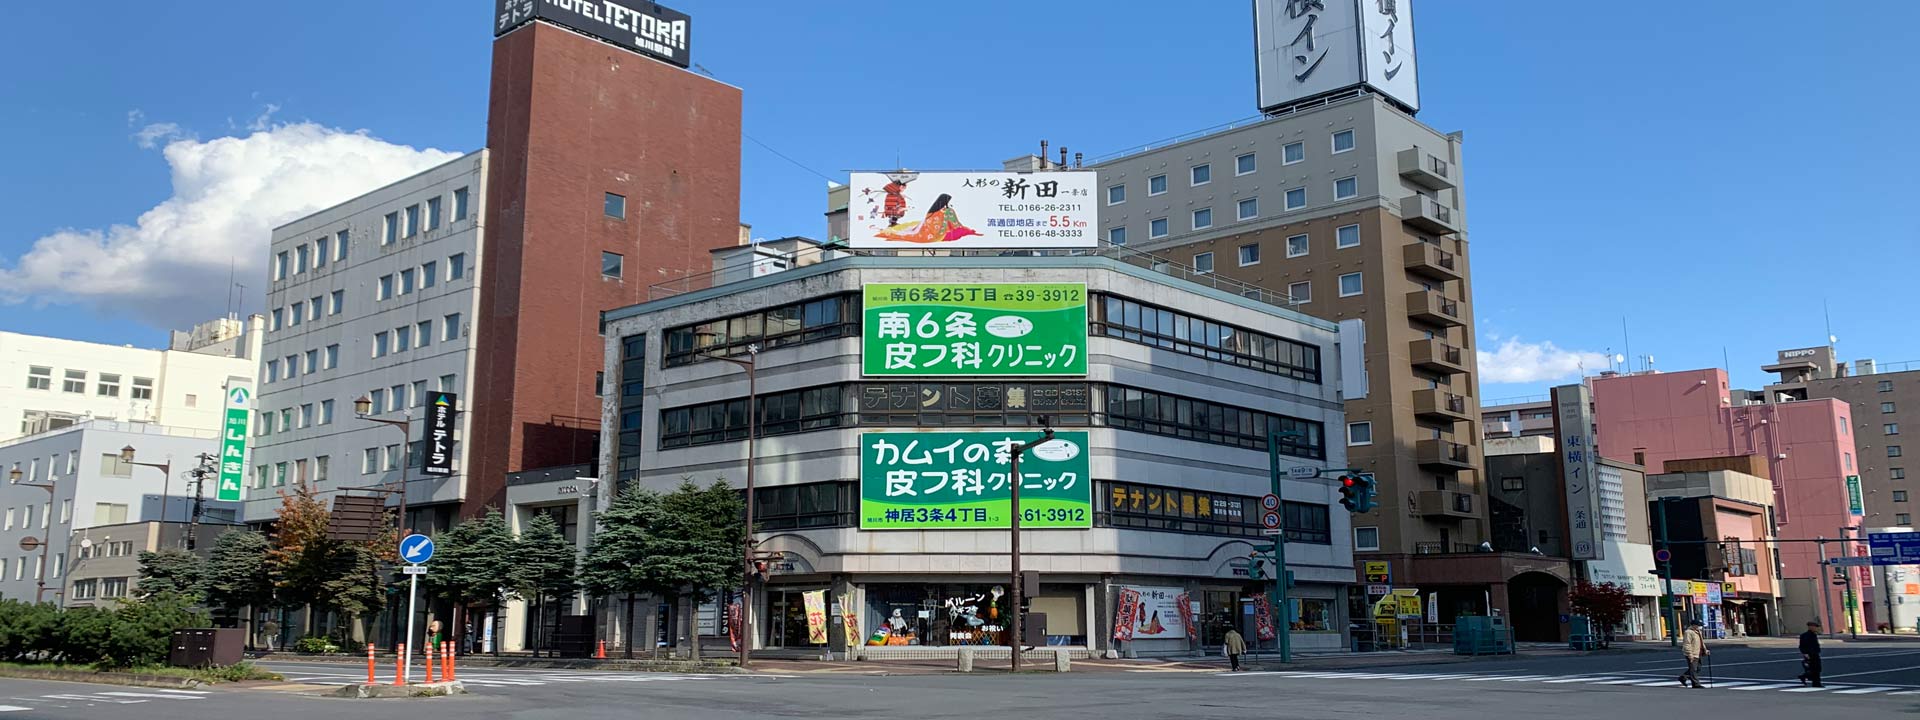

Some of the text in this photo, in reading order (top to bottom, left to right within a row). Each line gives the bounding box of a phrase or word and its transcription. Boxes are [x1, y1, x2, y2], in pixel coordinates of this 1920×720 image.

[499, 3, 533, 29] テトラ
[603, 1, 685, 50] TETORA
[1050, 215, 1070, 228] 5.5
[890, 288, 997, 302] 南6条25丁目
[1016, 290, 1079, 301] 39-3912
[878, 311, 977, 339] 南6条
[885, 342, 1077, 369] 皮フ科クリニック
[1784, 349, 1816, 358] NIPPO
[222, 428, 245, 491] しんきん
[432, 429, 447, 464] テトラ
[1568, 435, 1584, 494] 東横イン
[885, 508, 987, 522] 神居3条4丁目
[1024, 509, 1085, 522] 61-3912
[1265, 498, 1275, 506] 40
[1725, 583, 1732, 591] P
